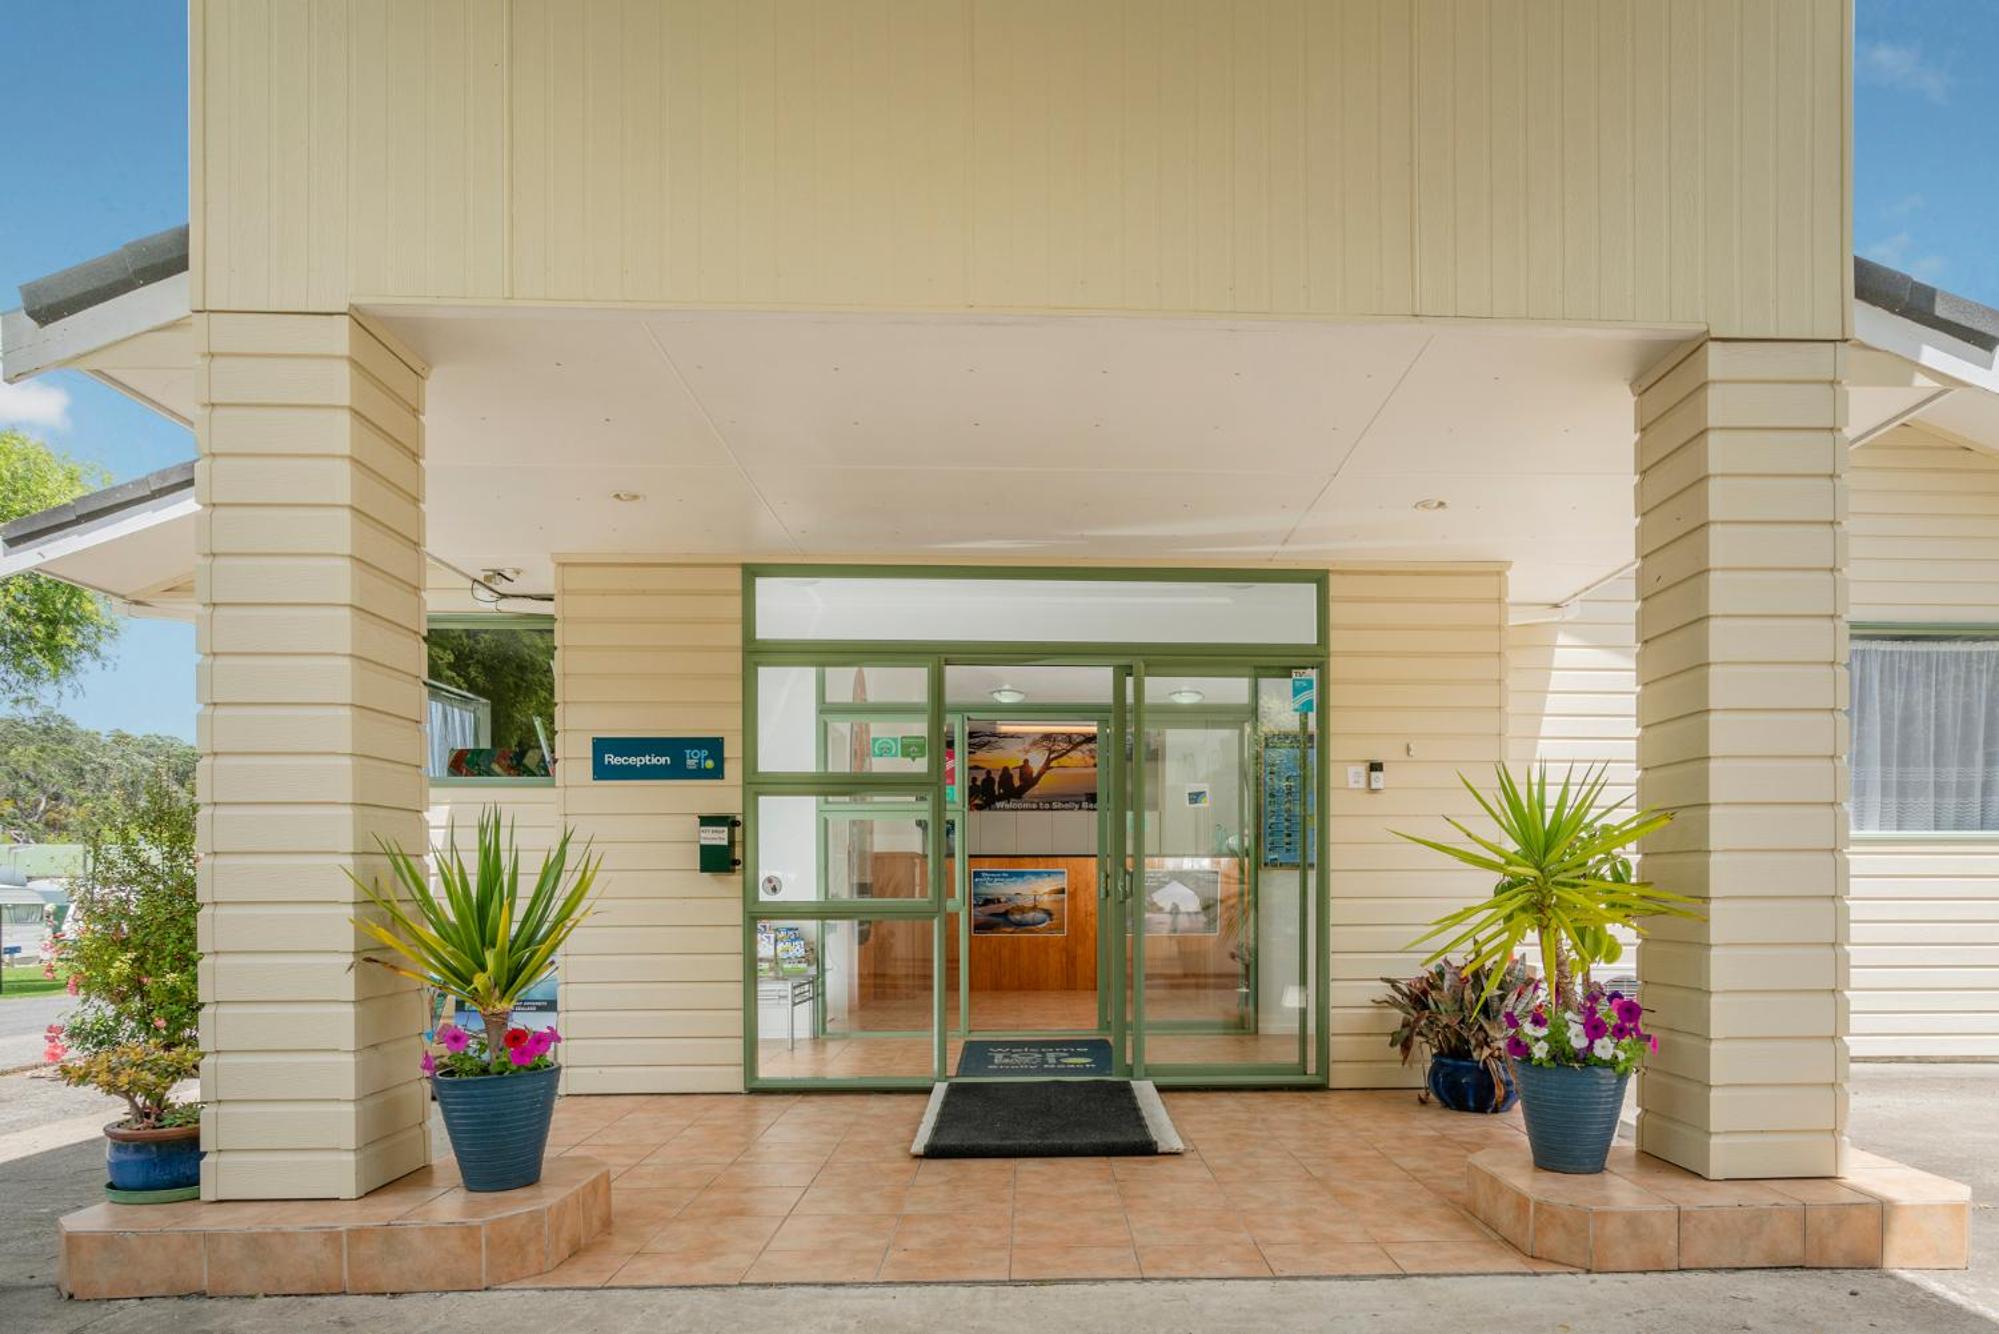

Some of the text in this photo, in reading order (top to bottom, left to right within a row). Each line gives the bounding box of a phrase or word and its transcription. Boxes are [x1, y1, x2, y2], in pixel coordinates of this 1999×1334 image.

[604, 753, 671, 767] Reception
[684, 749, 708, 769] TOP
[995, 801, 1037, 809] Welcome
[1040, 801, 1050, 809] to
[1052, 801, 1079, 811] Shelly
